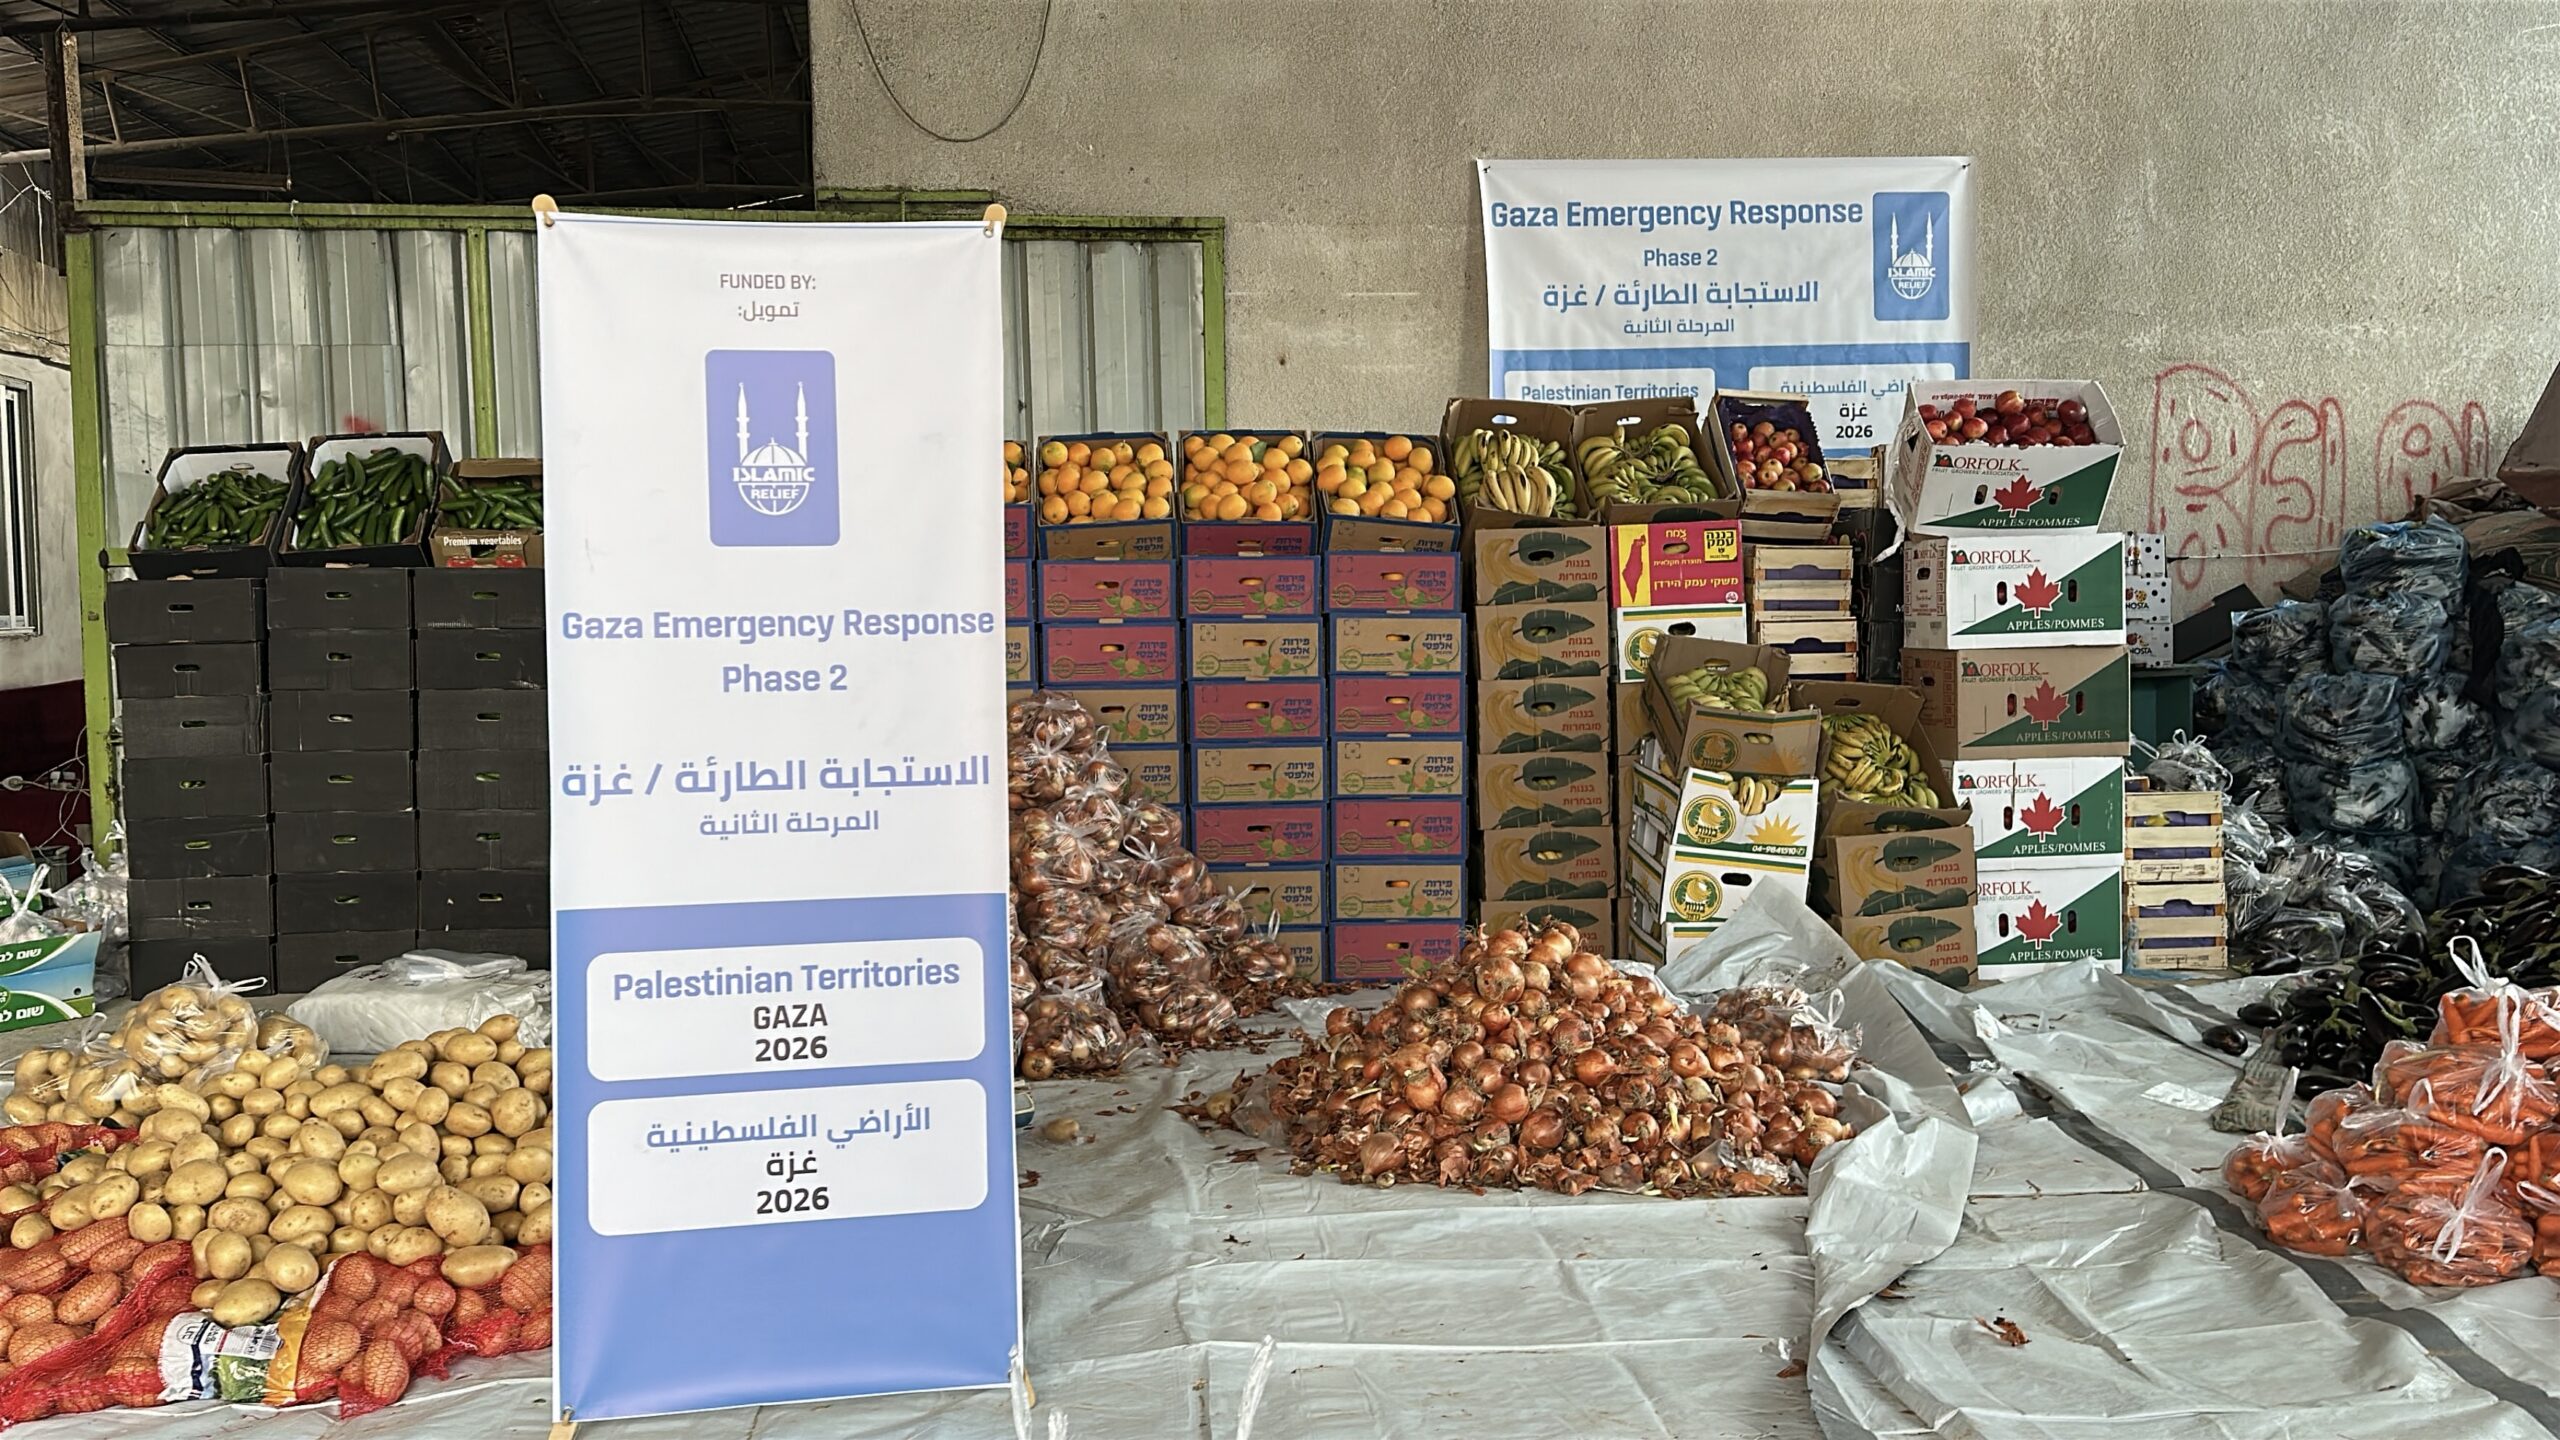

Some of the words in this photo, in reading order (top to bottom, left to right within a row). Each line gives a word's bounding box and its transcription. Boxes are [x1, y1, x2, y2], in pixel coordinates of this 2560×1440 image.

[1491, 202, 1558, 228] Gaza
[1567, 201, 1722, 232] Emergency
[1730, 201, 1864, 230] Response
[1644, 249, 1701, 267] Phase
[1706, 249, 1718, 267] 2
[1888, 267, 1937, 278] ISLAMIC
[719, 274, 786, 290] FUNDED
[789, 274, 817, 290] BY:
[1898, 281, 1928, 289] RELIEF
[1543, 284, 1588, 313] غزة
[1594, 284, 1607, 306] /
[1613, 282, 1697, 313] الطارئة
[1706, 281, 1819, 311] الاستجابة
[737, 300, 800, 322] تمويل:
[1623, 319, 1672, 337] الثانية
[1676, 318, 1735, 336] المرحلة
[1521, 384, 1611, 400] Palestinian
[1615, 382, 1699, 399] Territories
[1839, 402, 1868, 421] غزة
[1835, 425, 1873, 439] 2026
[1933, 453, 2023, 471] NORFOLK
[733, 466, 815, 482] ISLAMIC
[750, 488, 801, 500] RELIEF
[1978, 516, 2081, 527] APPLES/POMMES
[443, 536, 478, 546] Premium
[480, 534, 522, 546] vegetables
[1136, 536, 1164, 544] פירות
[1706, 531, 1734, 540] בננה
[1707, 539, 1734, 549] עמק
[1565, 559, 1591, 567] בננות
[1951, 549, 2033, 565] NORFOLK
[1558, 571, 1598, 581] מובחרות
[1654, 580, 1681, 591] הירדן
[1685, 579, 1707, 590] עמק
[1710, 577, 1739, 588] משקי
[562, 612, 644, 640] Gaza
[653, 611, 835, 645] Emergency
[843, 609, 995, 641] Response
[2006, 617, 2105, 630] APPLES/POMMES
[1282, 638, 1310, 646] פירות
[1425, 633, 1453, 641] פירות
[1568, 636, 1593, 645] בננות
[1139, 641, 1168, 649] פירות
[1279, 646, 1310, 655] אלפסי
[1422, 642, 1453, 650] אלפסי
[1561, 649, 1601, 659] מובחרות
[1961, 662, 2040, 676] NORFOLK
[722, 664, 821, 693] Phase
[829, 664, 848, 691] 2
[1140, 704, 1169, 712] פירות
[1569, 710, 1594, 718] בננות
[1137, 712, 1169, 721] אלפסי
[1562, 722, 1601, 732] מובחרות
[2016, 729, 2111, 742] APPLES/POMMES
[1426, 756, 1454, 764] פירות
[1143, 765, 1171, 773] פירות
[1284, 771, 1314, 779] אלפסי
[1423, 765, 1454, 773] אלפסי
[644, 764, 663, 796] /
[674, 756, 806, 801] الطارئة
[819, 755, 990, 796] الاستجابة
[1140, 773, 1171, 781] אלפסי
[562, 763, 633, 806] غزة
[1570, 784, 1595, 792] בננות
[1563, 797, 1602, 806] מובחרות
[699, 810, 778, 841] الثانية
[786, 810, 879, 838] المرحلة
[1695, 826, 1718, 837] בננות
[2013, 841, 2106, 855] APPLES/POMMES
[1575, 857, 1600, 866] בננות
[1933, 863, 1960, 873] בננות
[1568, 871, 1608, 880] מובחרות
[1926, 876, 1968, 887] מובחרות
[1284, 886, 1313, 894] פירות
[1281, 894, 1313, 903] אלפסי
[1684, 901, 1706, 912] בננות
[1936, 942, 1960, 952] בננות
[16, 948, 42, 960] שום
[2009, 947, 2103, 962] APPLES/POMMES
[1929, 954, 1969, 967] מובחרות
[613, 966, 793, 1001] Palestinian
[800, 957, 961, 991] Territories
[16, 1004, 45, 1020] שום
[753, 1003, 828, 1030] GAZA
[755, 1036, 828, 1062] 2026
[827, 1103, 931, 1149] الأراضي
[646, 1114, 817, 1152] الفلسطينية
[765, 1151, 818, 1183] غزة
[756, 1187, 830, 1214] 2026
